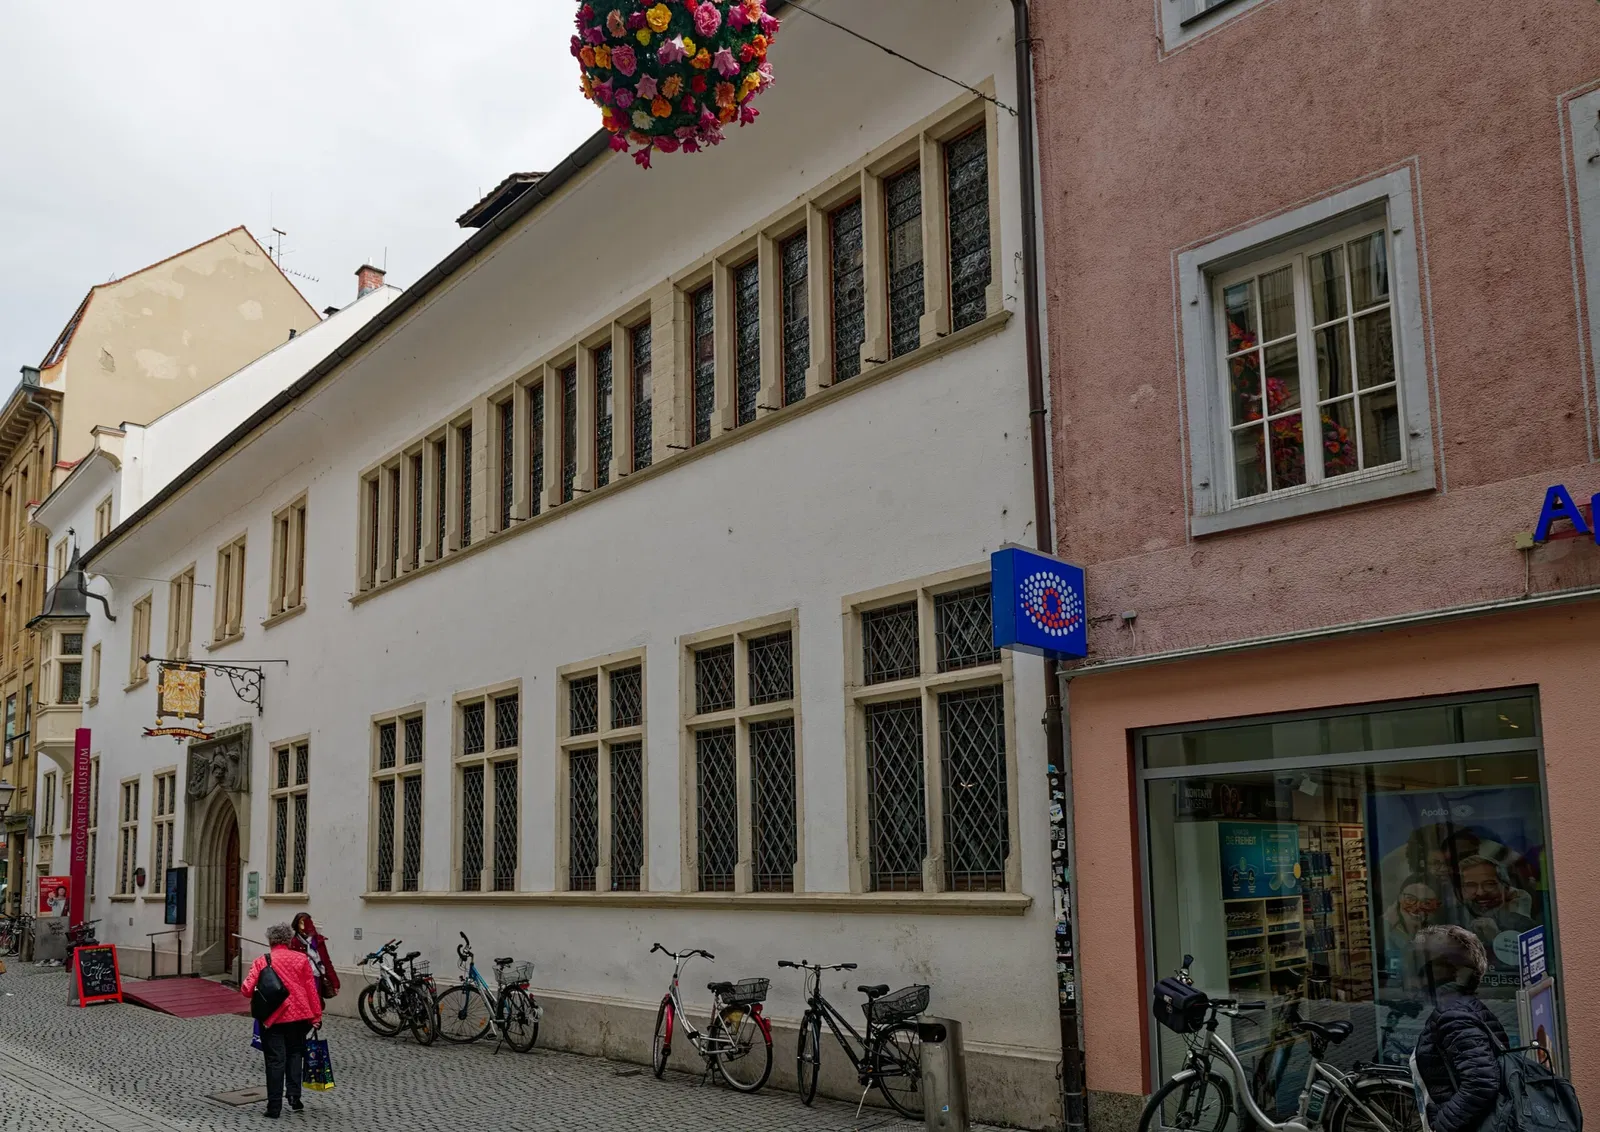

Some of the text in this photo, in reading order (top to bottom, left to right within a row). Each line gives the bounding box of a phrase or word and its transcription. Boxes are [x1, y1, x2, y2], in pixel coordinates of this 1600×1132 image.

[75, 747, 90, 862] ROSGARTENMUSEUM
[1421, 807, 1449, 819] Apollo
[101, 984, 117, 993] IDEA
